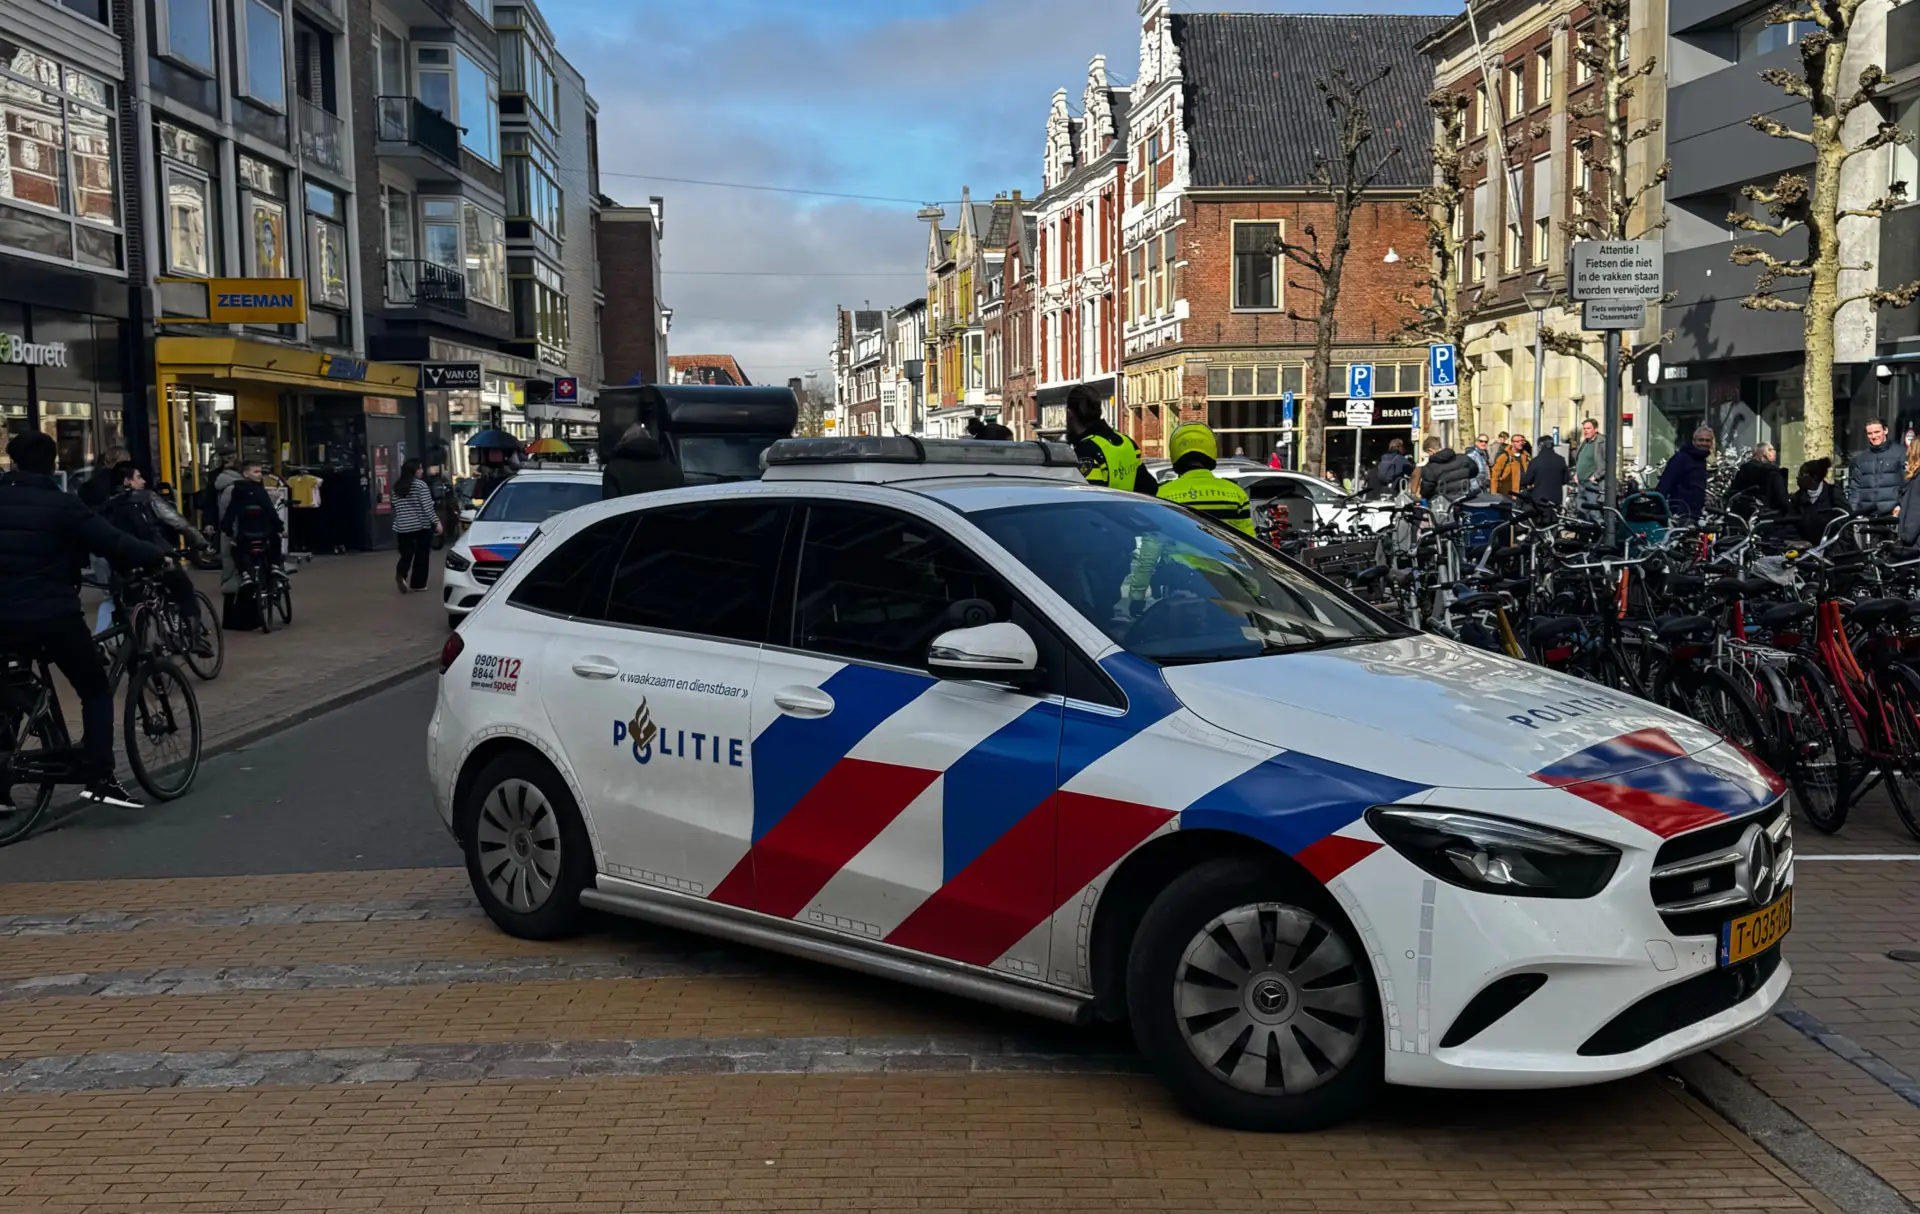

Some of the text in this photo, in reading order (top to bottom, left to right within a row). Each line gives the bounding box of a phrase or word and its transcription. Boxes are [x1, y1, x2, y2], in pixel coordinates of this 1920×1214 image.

[1599, 244, 1634, 255] Attentie
[1585, 258, 1653, 268] Fietsen die niet
[1578, 271, 1659, 281] in de vakken staan
[1577, 284, 1660, 296] worden verwijderd
[217, 294, 294, 308] ZEEMAN
[11, 334, 68, 368] Barrett
[1436, 347, 1450, 369] P
[445, 370, 479, 379] VAN OS
[1354, 367, 1368, 385] P
[1382, 409, 1413, 418] BEANS
[475, 654, 498, 667] 0900
[472, 667, 494, 680] 8844
[497, 657, 521, 679] 112
[494, 680, 517, 692] spoed
[627, 672, 675, 688] waakzaam
[676, 680, 688, 690] en
[689, 679, 741, 698] dienstbaar
[1506, 697, 1627, 729] POLITIE
[613, 719, 743, 767] POLITIE
